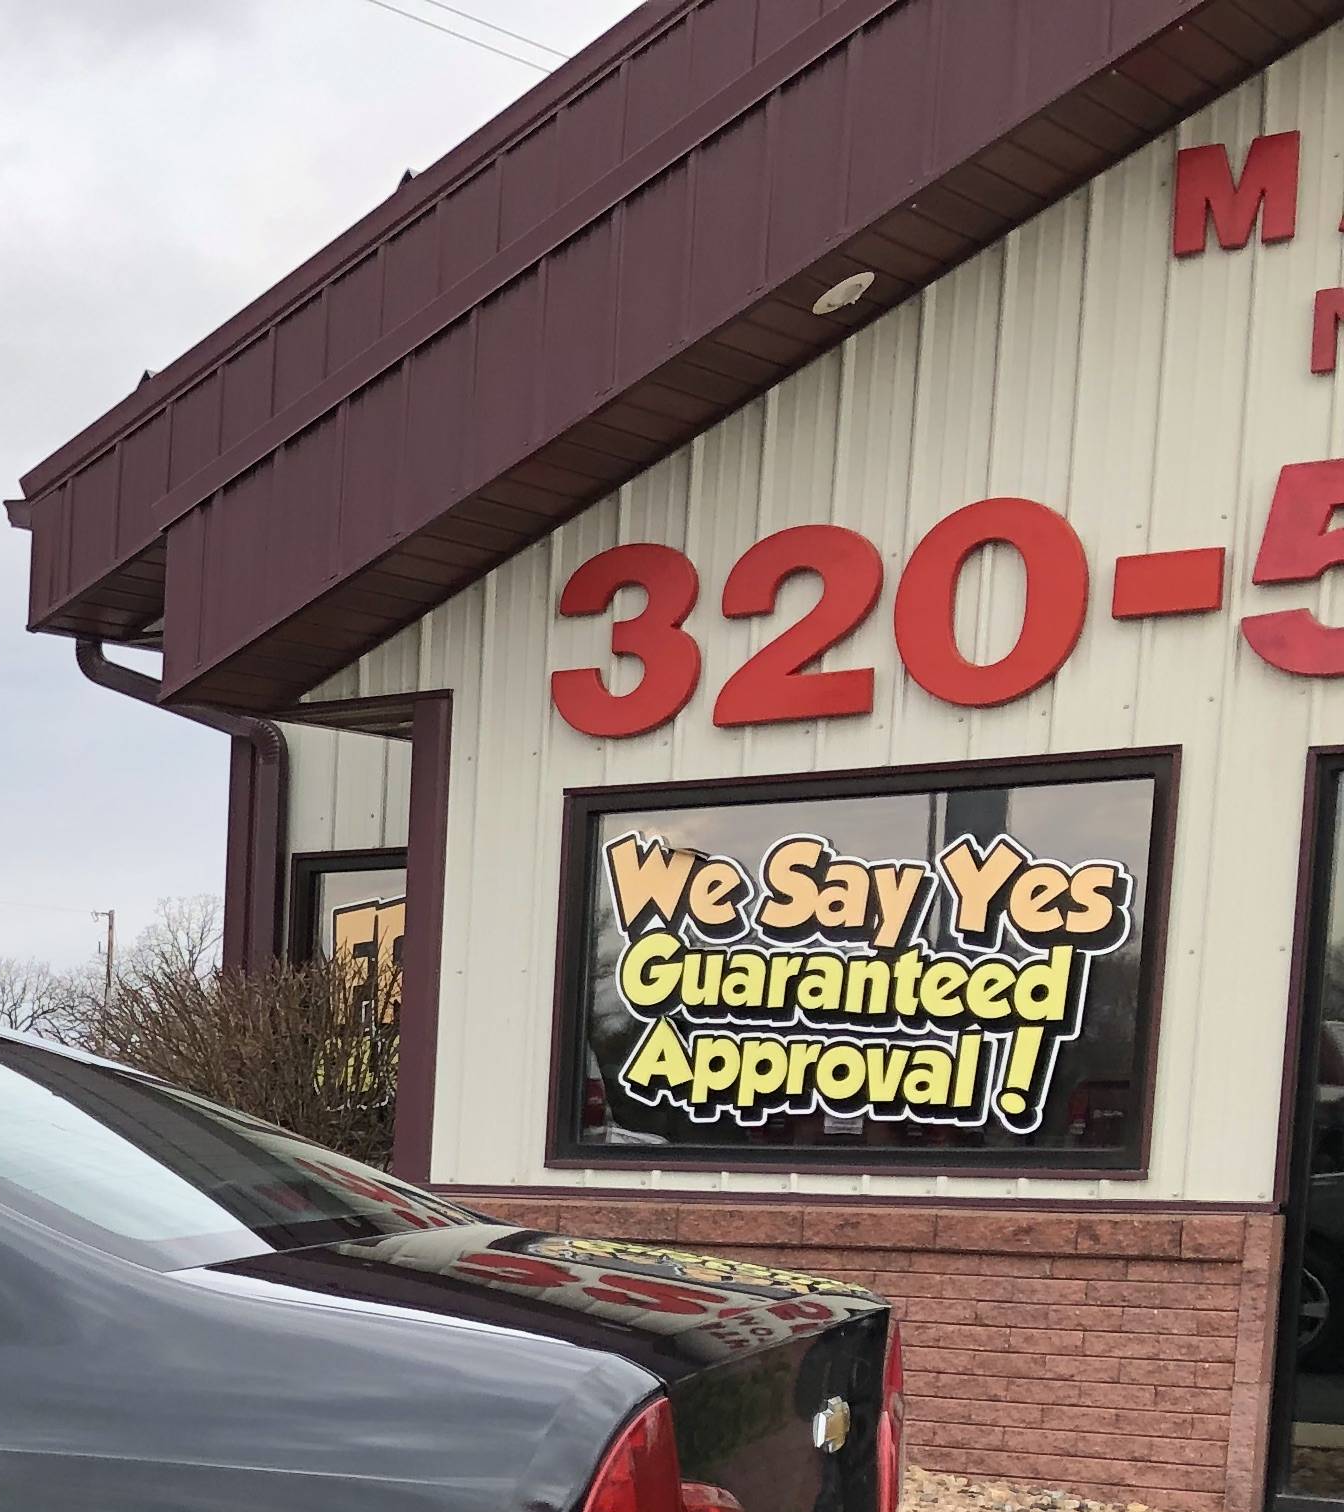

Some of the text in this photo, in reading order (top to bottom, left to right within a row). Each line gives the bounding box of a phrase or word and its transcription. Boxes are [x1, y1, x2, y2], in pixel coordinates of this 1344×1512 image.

[605, 833, 1119, 950] We Say Yes
[619, 930, 1075, 1023] Guaranteed
